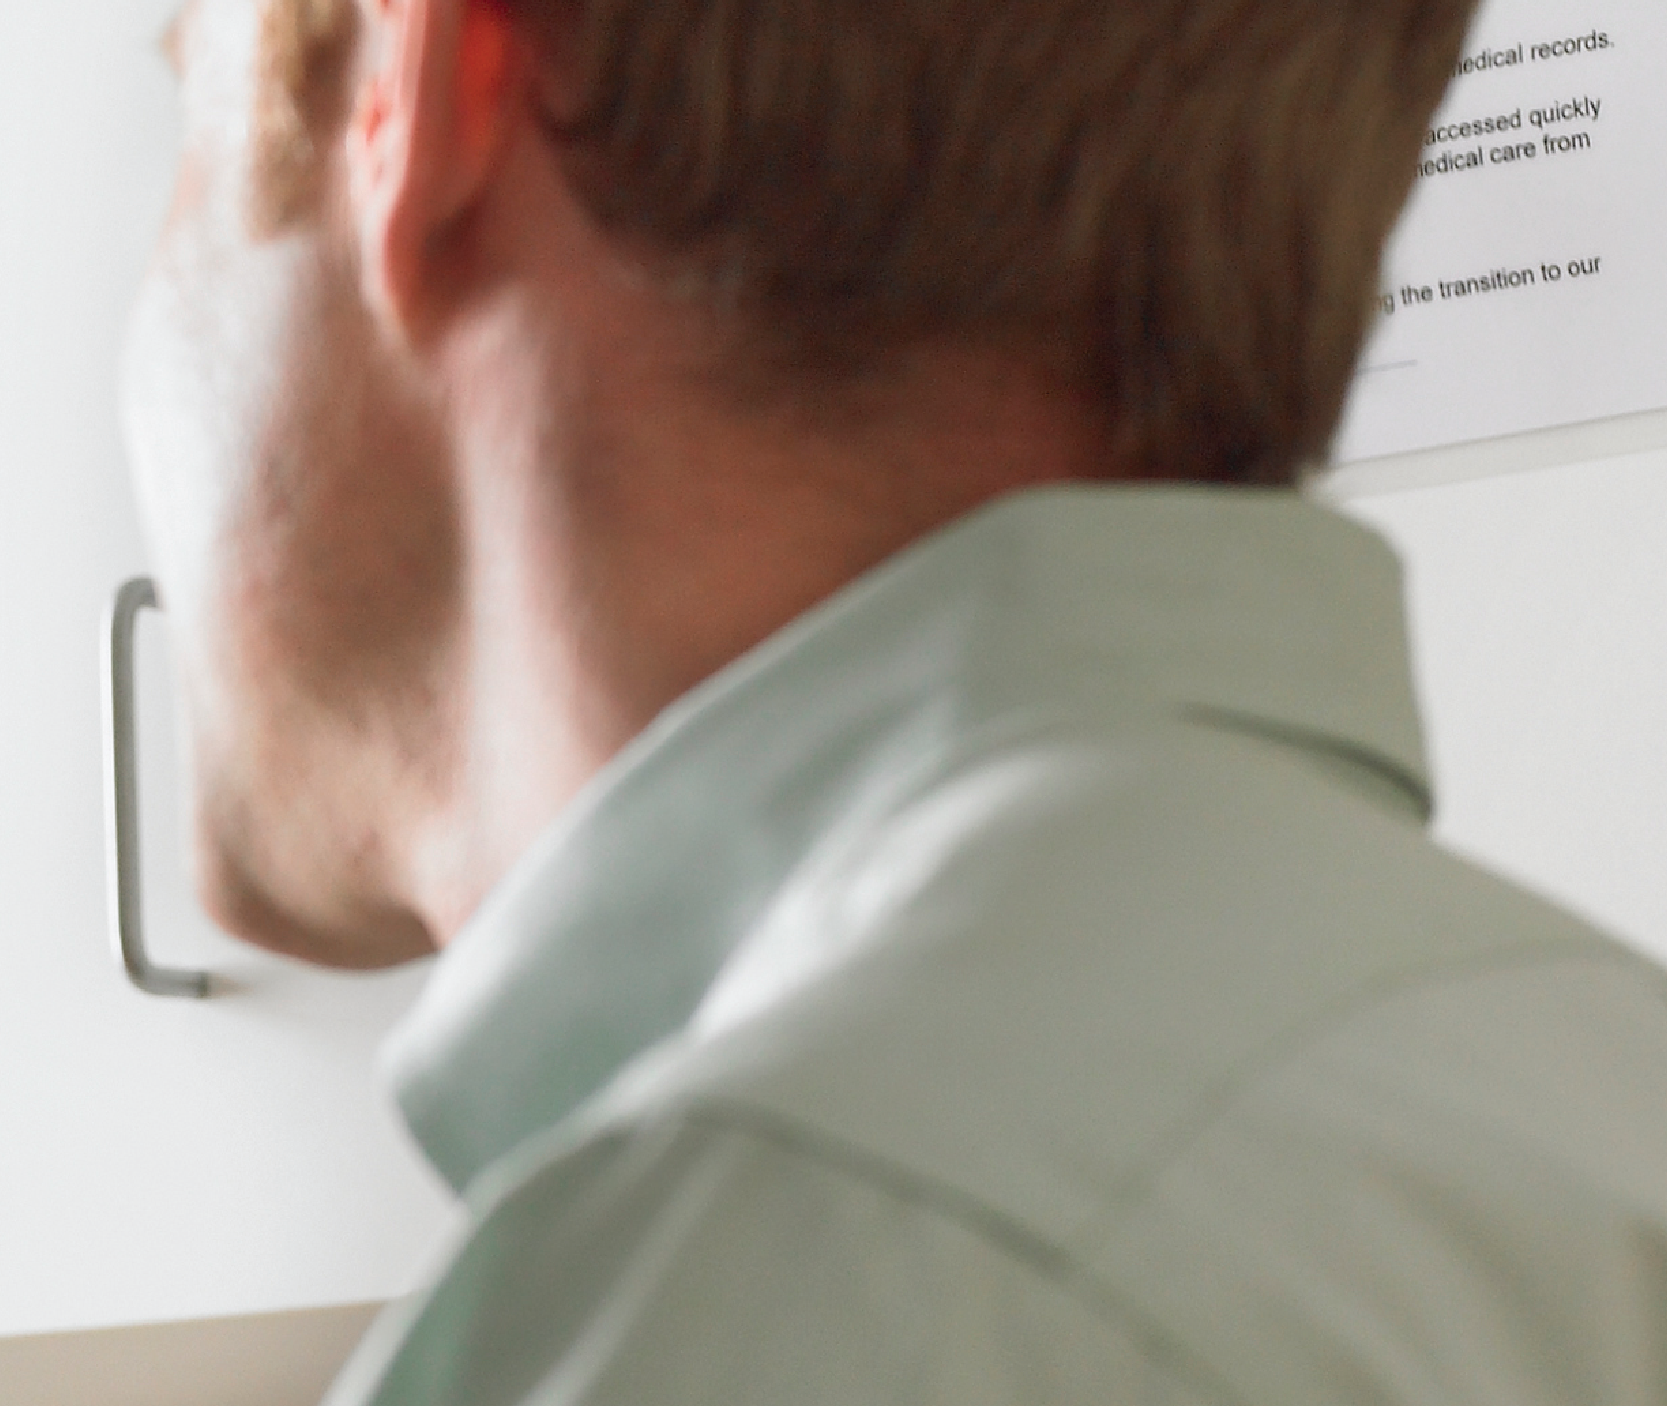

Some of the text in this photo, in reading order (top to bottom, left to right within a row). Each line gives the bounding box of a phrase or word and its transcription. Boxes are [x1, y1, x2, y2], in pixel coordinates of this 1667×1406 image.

[1531, 29, 1614, 61] records.
[1425, 94, 1602, 146] accessed quickly
[1490, 141, 1536, 164] care
[1543, 132, 1592, 154] from
[1400, 284, 1434, 306] the
[1438, 266, 1536, 299] transition
[1540, 262, 1563, 282] to
[1567, 256, 1601, 278] our
